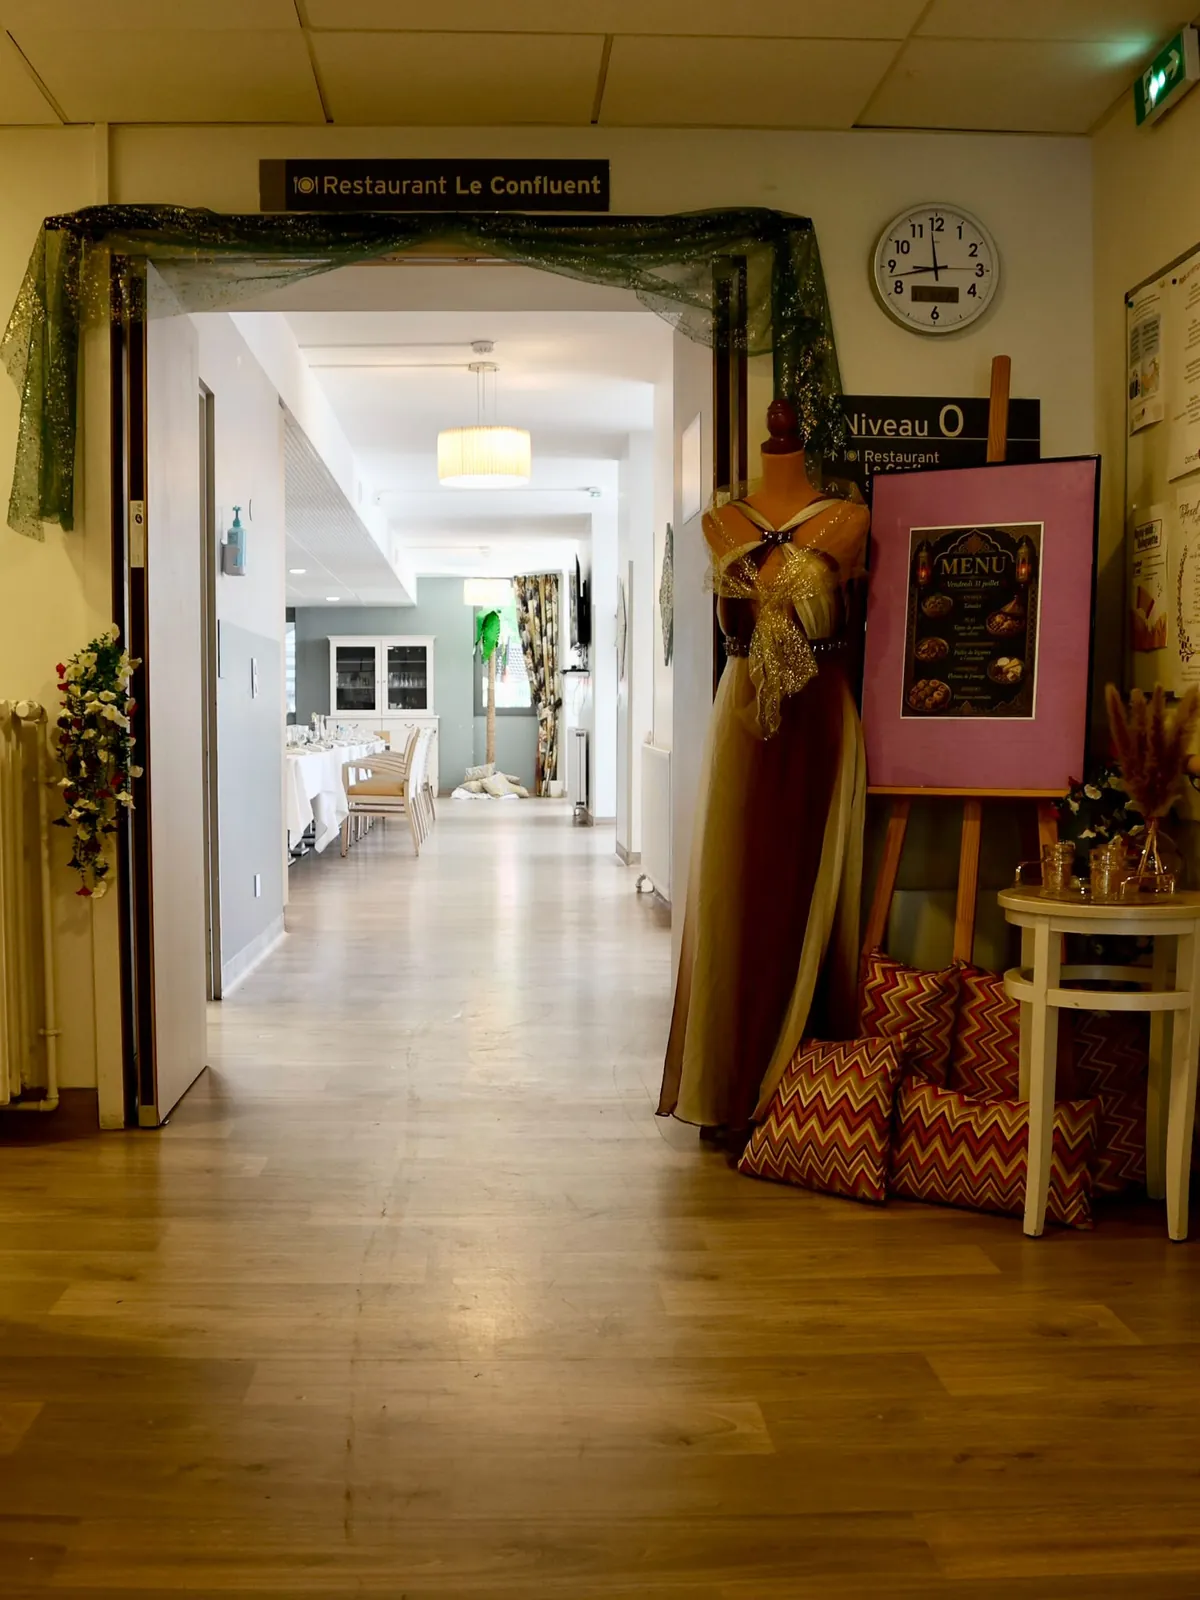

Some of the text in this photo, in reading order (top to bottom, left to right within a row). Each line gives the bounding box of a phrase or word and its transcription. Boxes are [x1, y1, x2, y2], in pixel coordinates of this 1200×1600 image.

[324, 175, 601, 195] Restaurant Le Confluent
[910, 224, 923, 238] 11
[929, 217, 944, 232] 12
[956, 225, 963, 240] 1
[894, 240, 910, 254] 10
[968, 243, 978, 257] 2
[888, 259, 897, 273] 9
[975, 263, 985, 277] 3
[894, 280, 903, 294] 8
[967, 283, 977, 297] 4
[930, 306, 939, 320] 6
[844, 413, 929, 436] Niveau
[864, 450, 940, 464] Restaurant
[940, 556, 1006, 575] MENU
